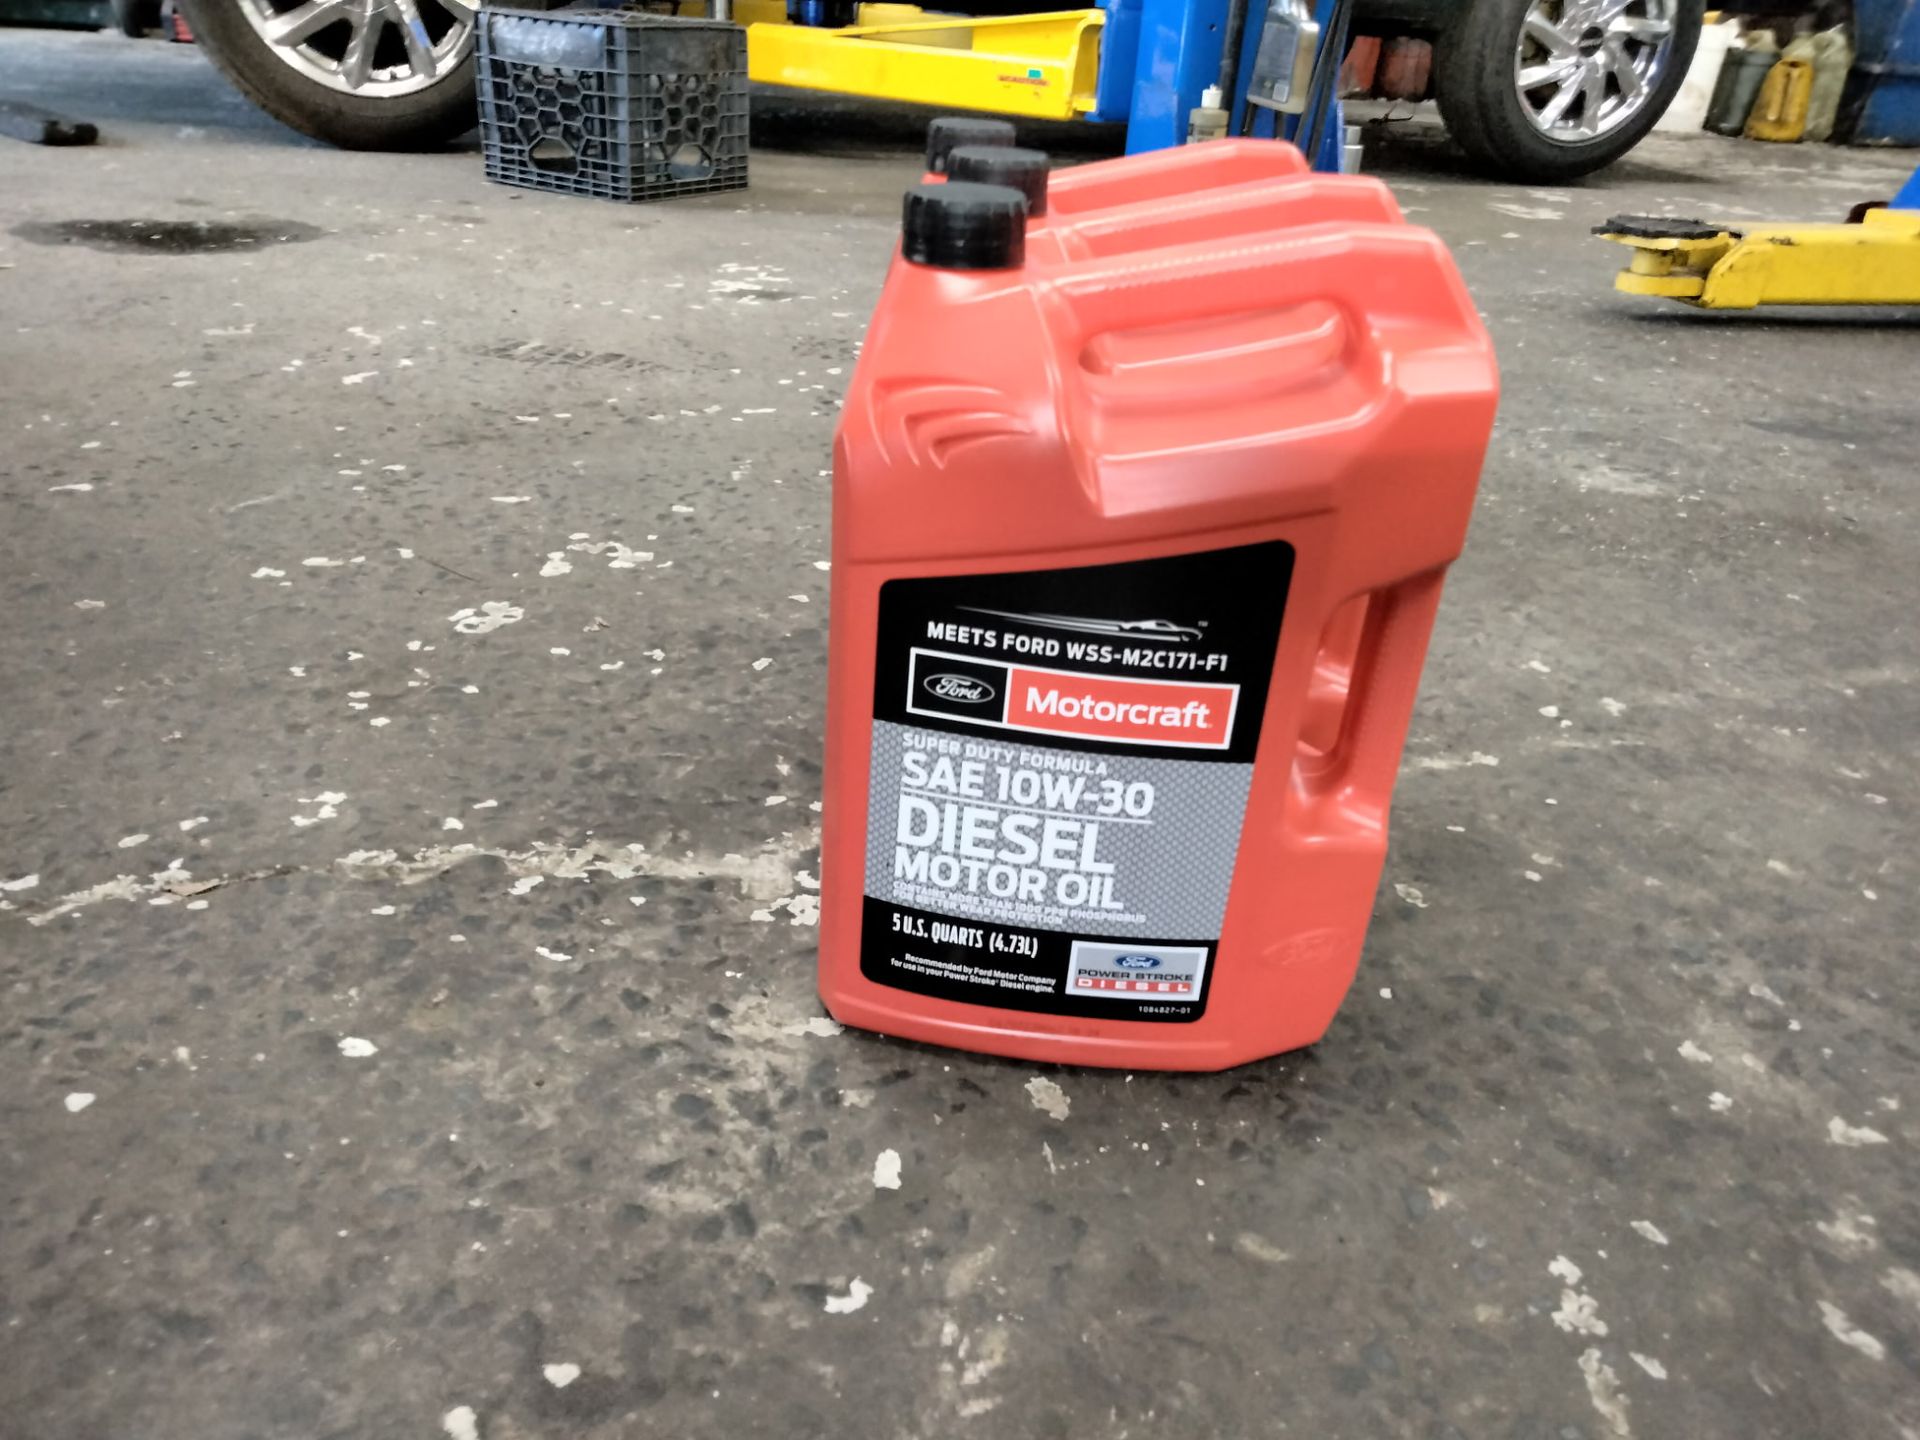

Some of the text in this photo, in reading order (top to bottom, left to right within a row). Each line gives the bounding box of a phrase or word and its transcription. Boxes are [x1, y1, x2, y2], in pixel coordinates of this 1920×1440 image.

[927, 621, 1228, 672] MEETS FORD WSS-M2C171-F1
[935, 673, 983, 701] Ford
[1026, 686, 1211, 729] Motorcraft
[902, 732, 1108, 776] SUPER DUTY FORMULA
[901, 751, 1155, 817] SAE 10W-30
[897, 795, 1115, 874] DIESEL
[895, 845, 1124, 910] MOTOR OIL
[893, 888, 1063, 925] FOR BETTER WEAR PROTECTION
[949, 892, 979, 905] MORE
[983, 898, 1014, 910] THAN
[892, 913, 1038, 959] 5 U.S. QUARTS (4.73L)
[891, 958, 902, 967] for
[903, 962, 916, 971] use
[917, 964, 925, 973] in
[925, 968, 943, 977] your
[944, 971, 969, 981] Power
[1000, 980, 1024, 990] Diesel
[1025, 983, 1055, 994] engine.
[905, 953, 1056, 986] Recommended by Ford Motor Company
[1077, 978, 1189, 992] DIESEL
[1078, 968, 1193, 982] POWER STROKE
